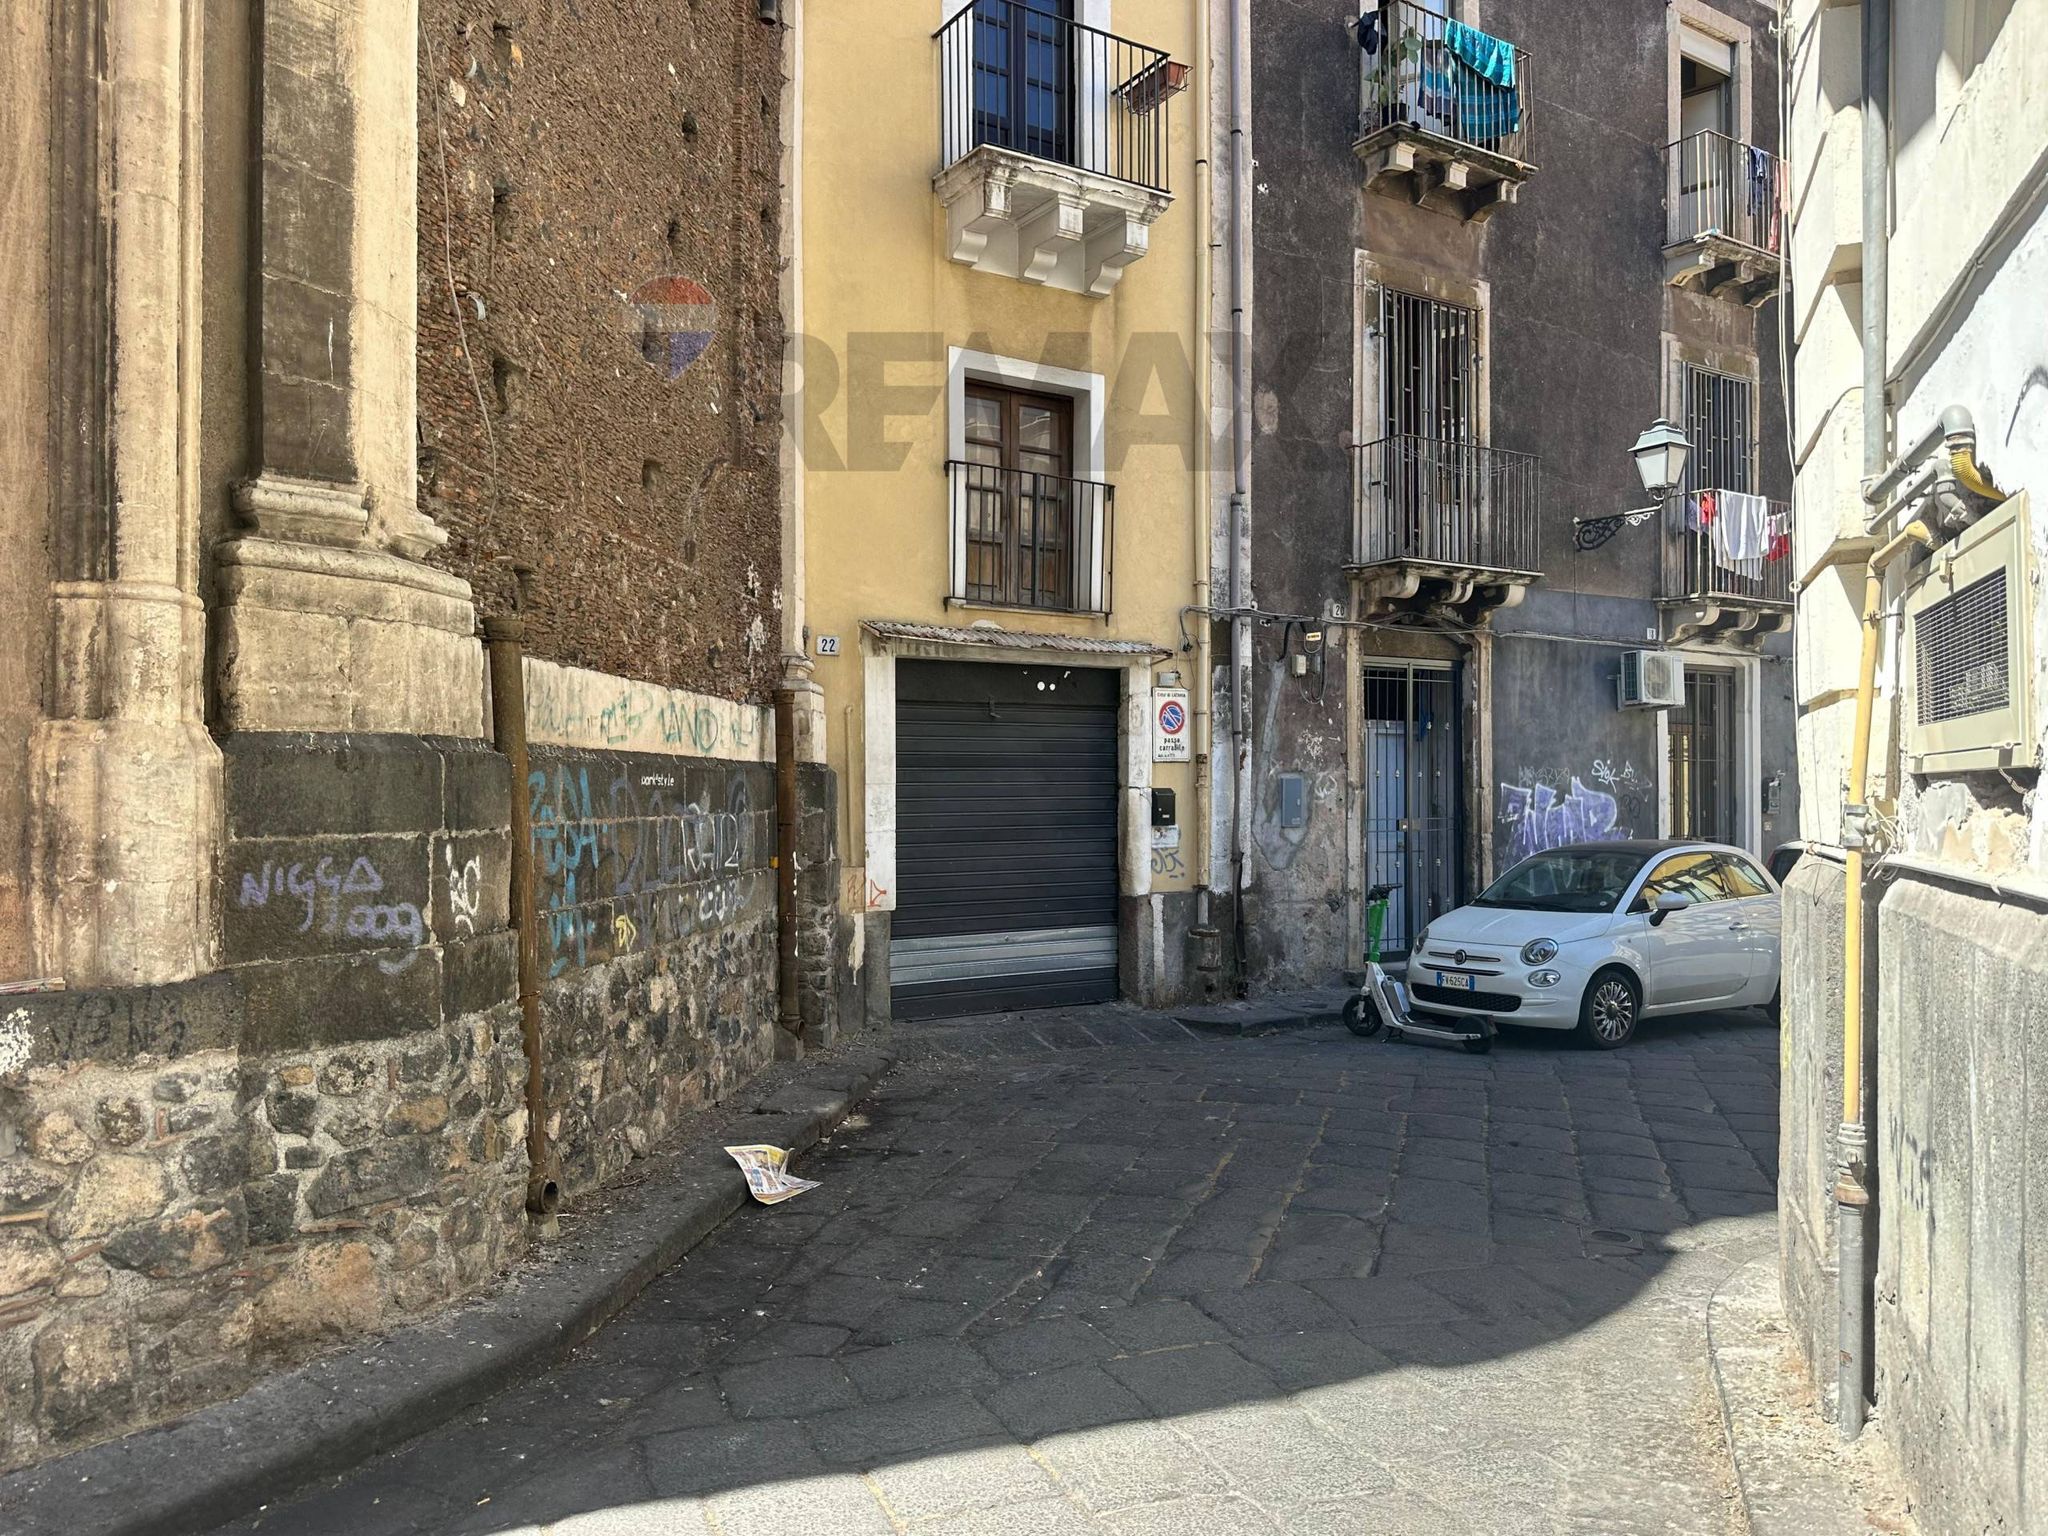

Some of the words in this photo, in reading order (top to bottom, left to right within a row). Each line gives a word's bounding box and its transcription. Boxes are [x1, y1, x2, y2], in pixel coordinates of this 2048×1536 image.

[1335, 605, 1345, 616] 20
[821, 638, 835, 652] 22
[1164, 737, 1180, 745] passo
